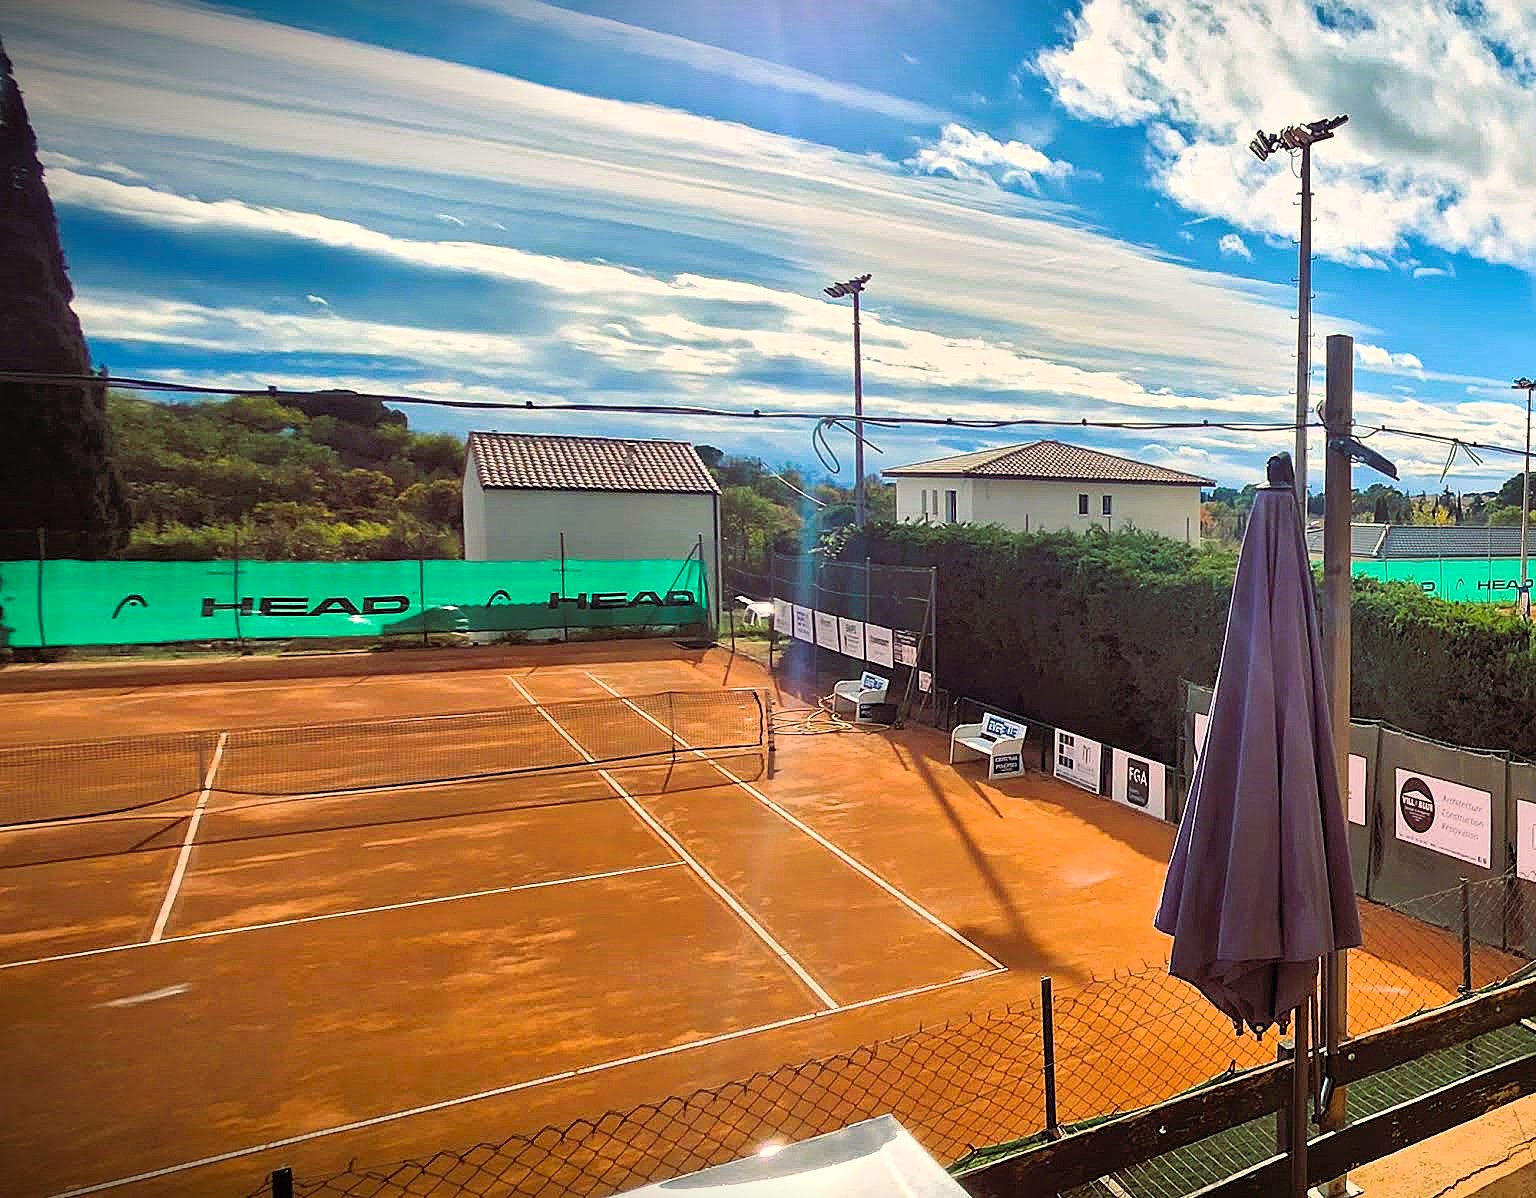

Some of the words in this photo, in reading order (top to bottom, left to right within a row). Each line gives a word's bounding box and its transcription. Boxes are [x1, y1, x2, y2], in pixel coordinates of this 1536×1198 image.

[1478, 580, 1534, 593] HEAD
[201, 595, 410, 617] HEAD
[549, 590, 697, 609] HEAD
[1128, 766, 1149, 787] FGA
